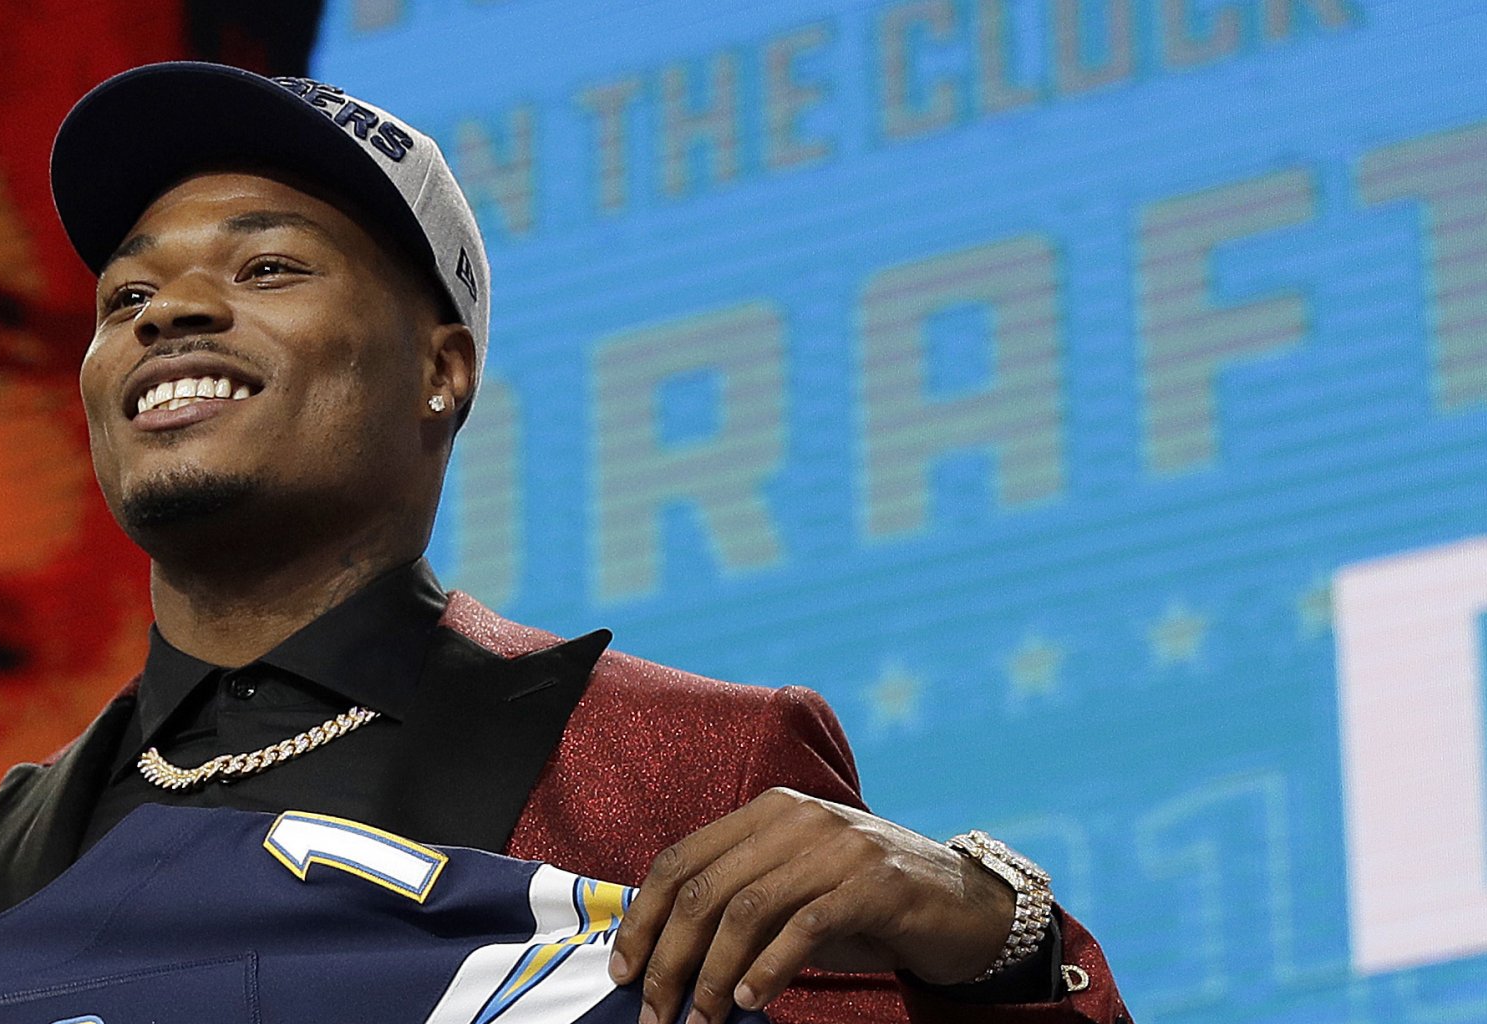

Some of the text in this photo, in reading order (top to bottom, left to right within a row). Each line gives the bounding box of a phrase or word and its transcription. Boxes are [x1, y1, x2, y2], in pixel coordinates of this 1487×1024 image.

[442, 103, 534, 237] N
[577, 22, 830, 216] THE
[263, 810, 450, 904] 1
